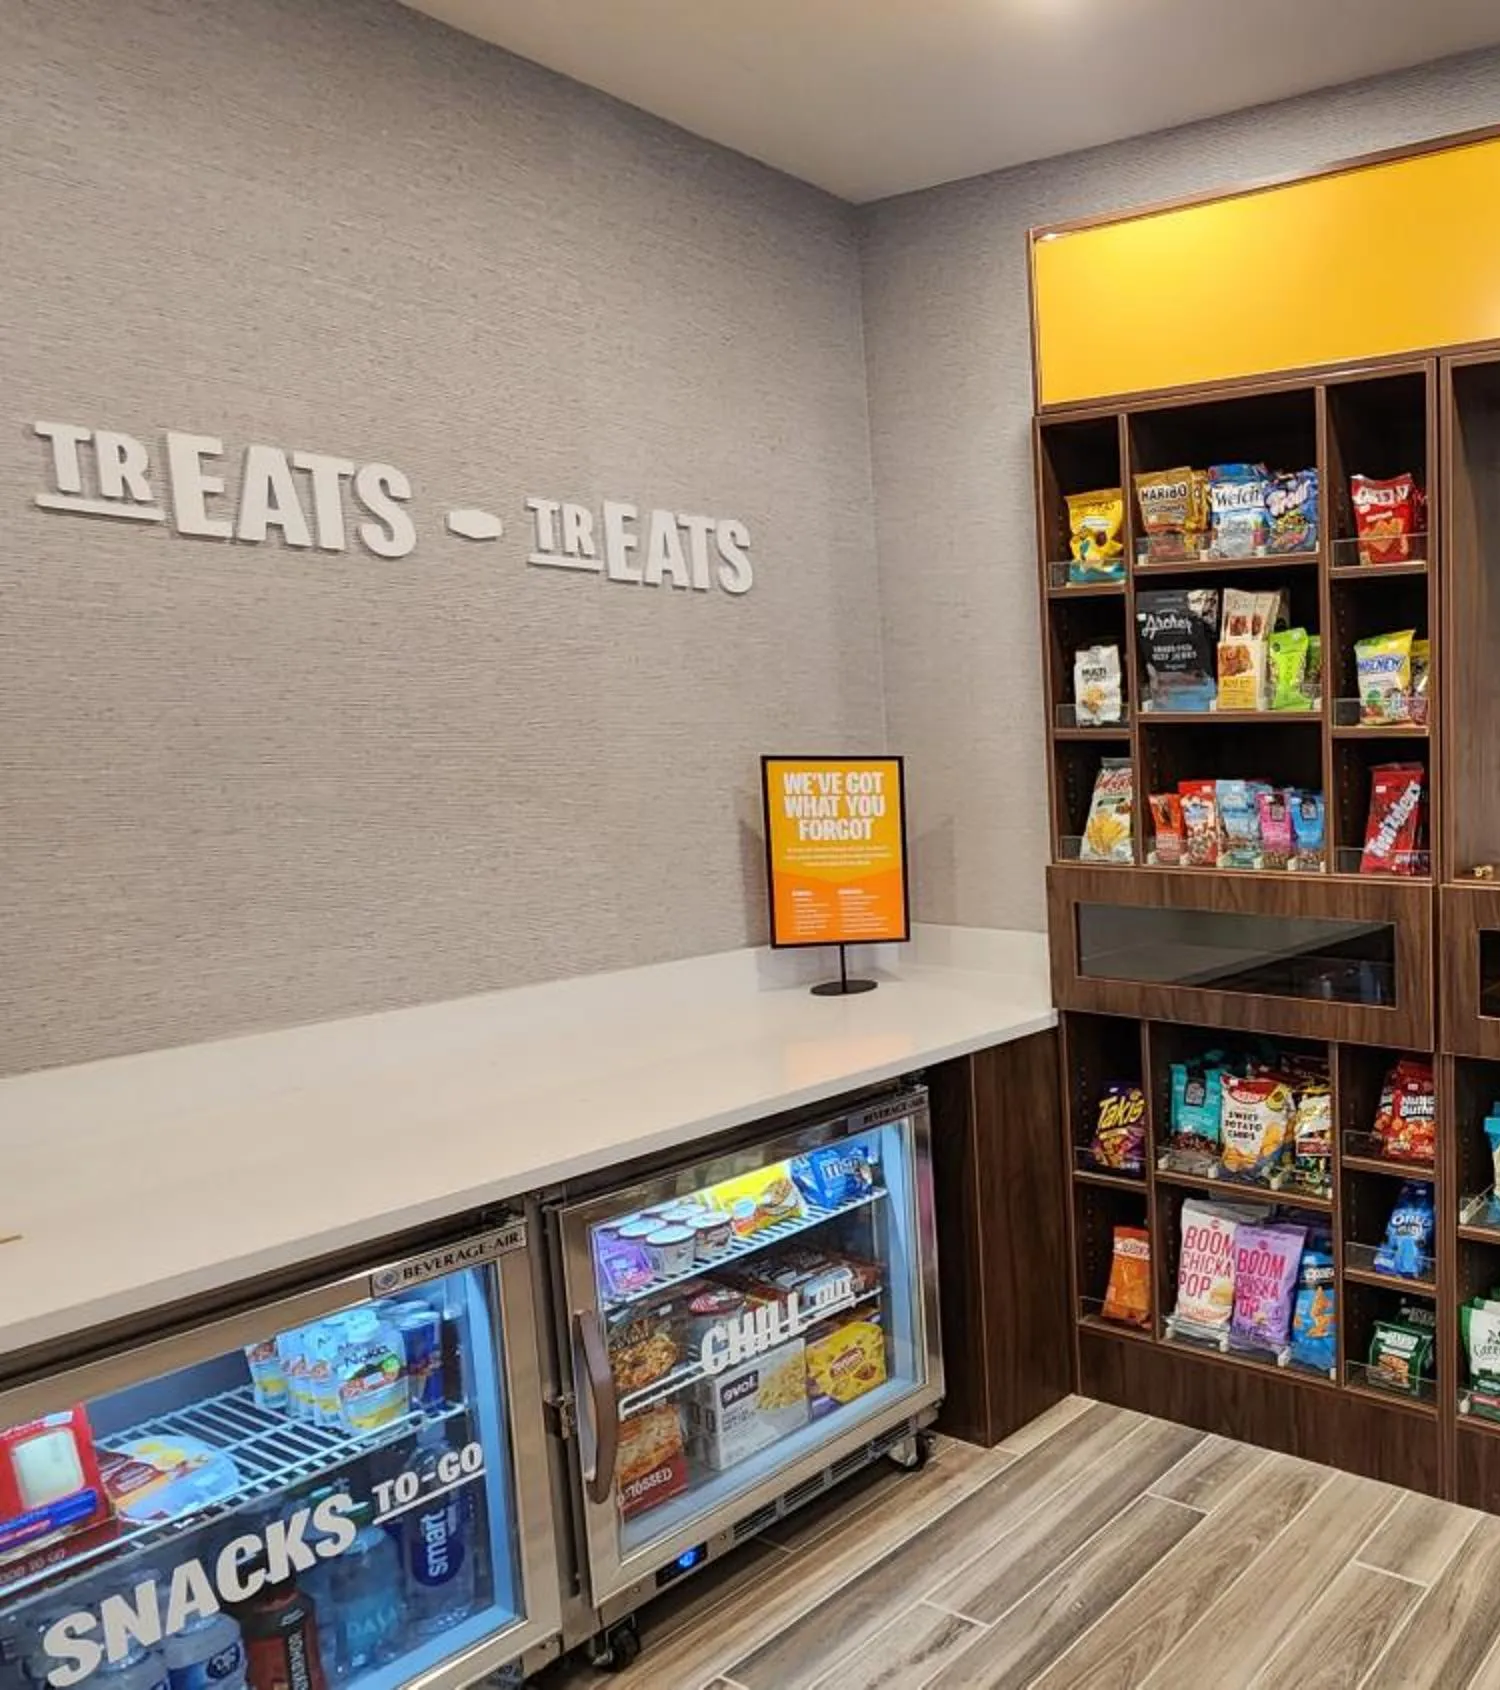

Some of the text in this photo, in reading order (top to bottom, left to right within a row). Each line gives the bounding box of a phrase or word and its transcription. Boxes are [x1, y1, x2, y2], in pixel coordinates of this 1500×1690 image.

[35, 421, 753, 594] TREATS TREATS
[1141, 484, 1187, 502] HARIBO
[784, 771, 885, 795] WE'VE GOT
[785, 795, 886, 818] WHAT YOU
[799, 817, 874, 841] FORGOT
[1099, 1092, 1145, 1128] Takis
[1184, 1226, 1236, 1260] BOOM
[1181, 1251, 1232, 1279] CHICKA
[1237, 1248, 1286, 1278] BOOM
[1179, 1268, 1211, 1299] POP
[421, 1508, 449, 1577] smart
[43, 1441, 485, 1688] SNACKS TO-GO
